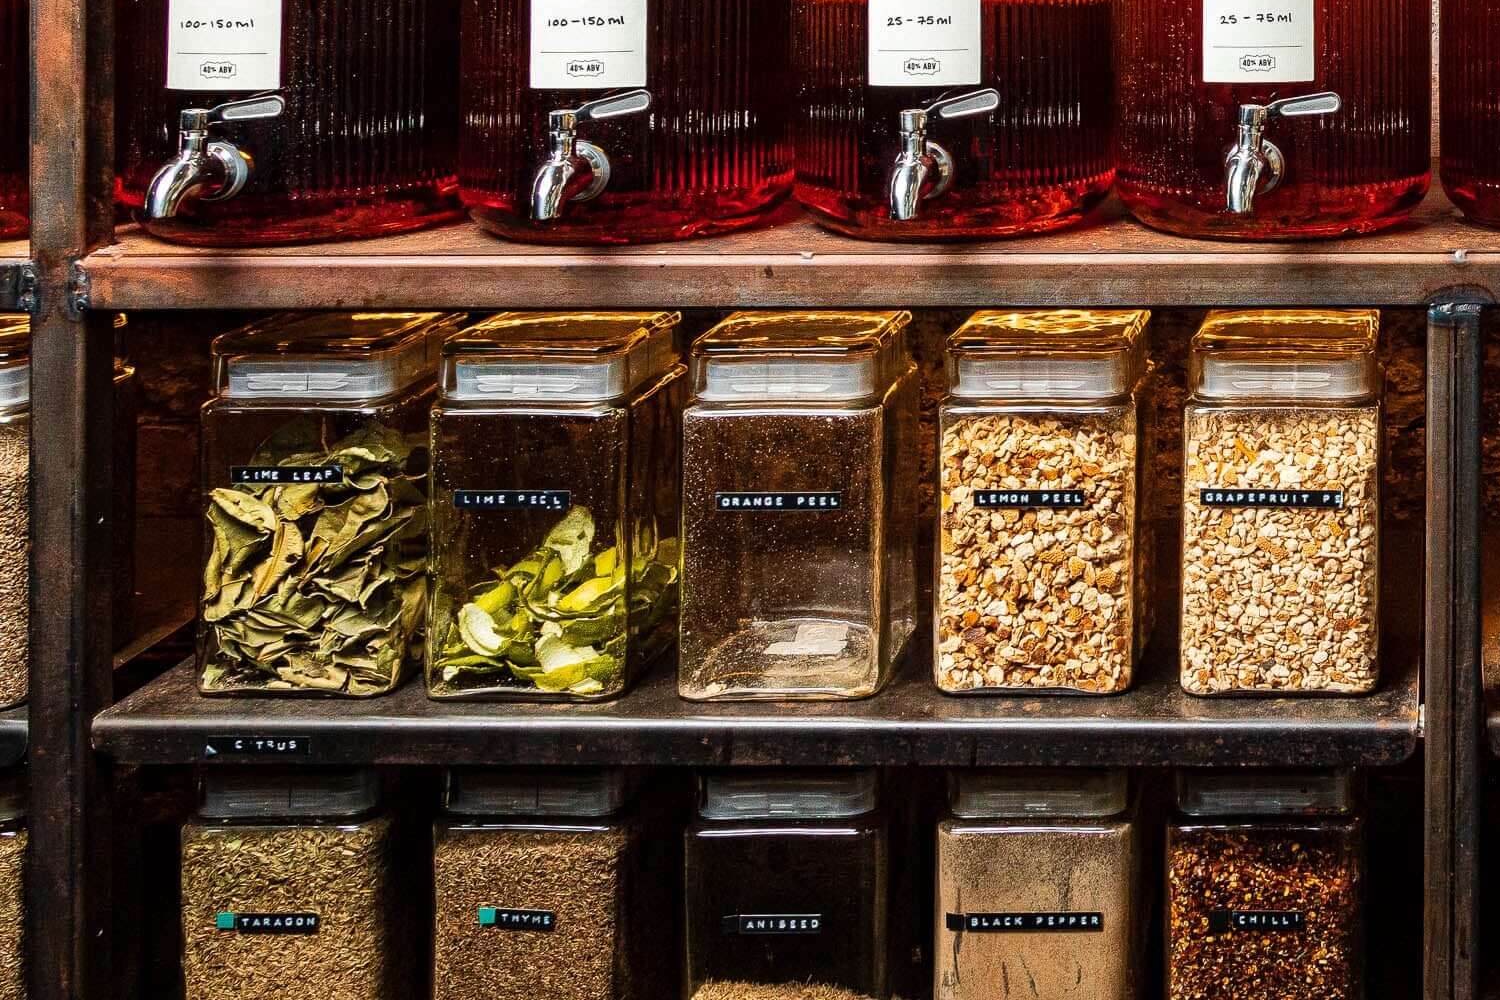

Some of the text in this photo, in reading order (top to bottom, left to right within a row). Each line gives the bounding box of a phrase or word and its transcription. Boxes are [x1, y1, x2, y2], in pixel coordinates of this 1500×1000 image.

[587, 64, 600, 72] ABV
[1242, 59, 1272, 67] 40% ABV
[242, 468, 333, 481] LIME LEAF
[464, 495, 506, 504] LIME
[721, 496, 838, 507] ORANGE PEEL
[979, 493, 1082, 504] LEMON PEEL
[1205, 493, 1310, 504] GRAPEFRUIT
[234, 739, 297, 751] CTRUS
[242, 917, 316, 927] TARAGON
[501, 913, 550, 925] THYME
[746, 919, 819, 929] ANISEED
[971, 916, 1099, 927] BLACK PEPPER
[1239, 914, 1299, 925] CHILLI
